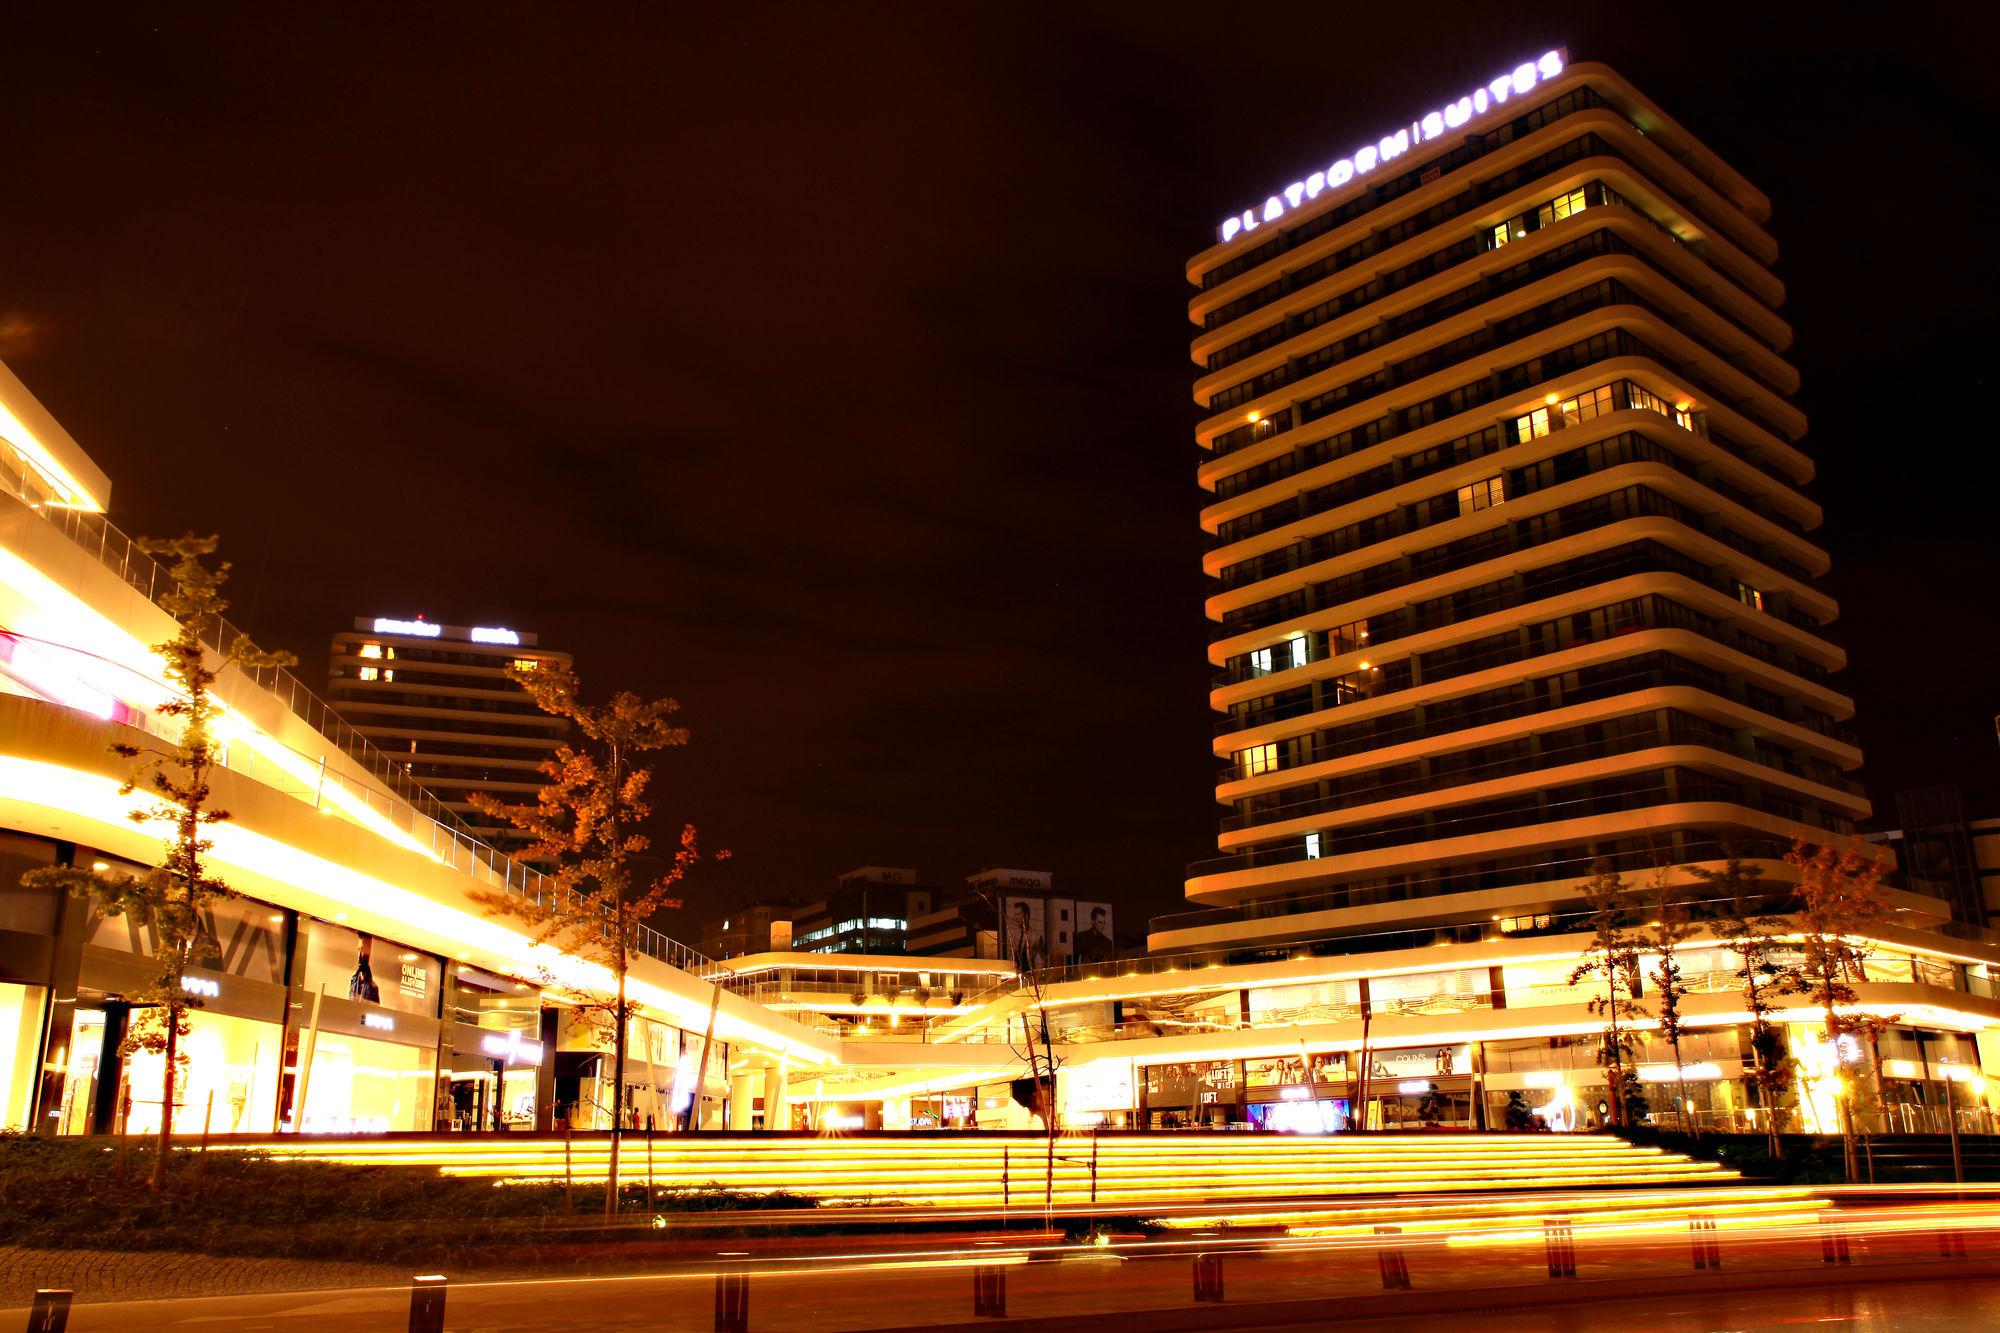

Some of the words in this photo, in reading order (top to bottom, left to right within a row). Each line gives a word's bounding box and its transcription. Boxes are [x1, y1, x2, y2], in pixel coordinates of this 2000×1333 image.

[1223, 129, 1409, 241] PLATFORM
[1421, 50, 1563, 140] SUITES
[881, 871, 903, 882] MG
[1009, 877, 1040, 889] mega
[402, 964, 426, 980] ONLINE
[1541, 986, 1579, 995] PLATFORM
[1396, 1053, 1426, 1064] COLIN'S
[1212, 1069, 1228, 1080] LOFT
[1200, 1092, 1218, 1103] LOFT
